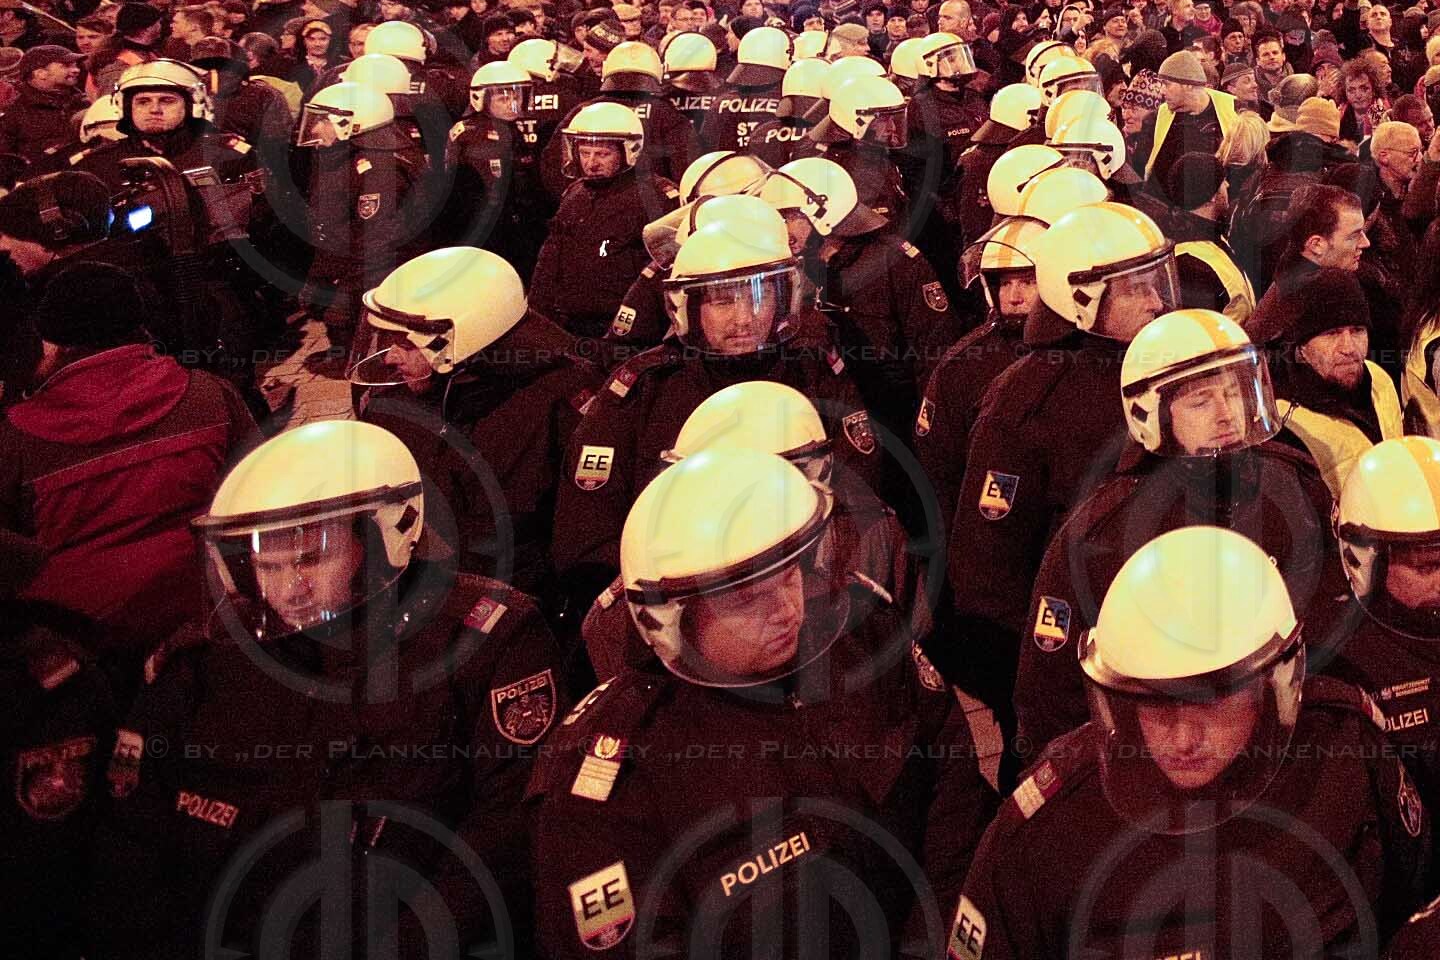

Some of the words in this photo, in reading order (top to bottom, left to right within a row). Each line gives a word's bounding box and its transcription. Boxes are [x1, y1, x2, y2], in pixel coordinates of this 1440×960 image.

[718, 98, 780, 114] POLIZE
[617, 311, 634, 325] EE
[582, 454, 610, 471] EE
[496, 676, 548, 704] POLIZEI
[176, 791, 240, 815] POLIZEI
[719, 831, 811, 897] POLIZEI
[580, 878, 625, 921] EE
[956, 912, 983, 956] EE
